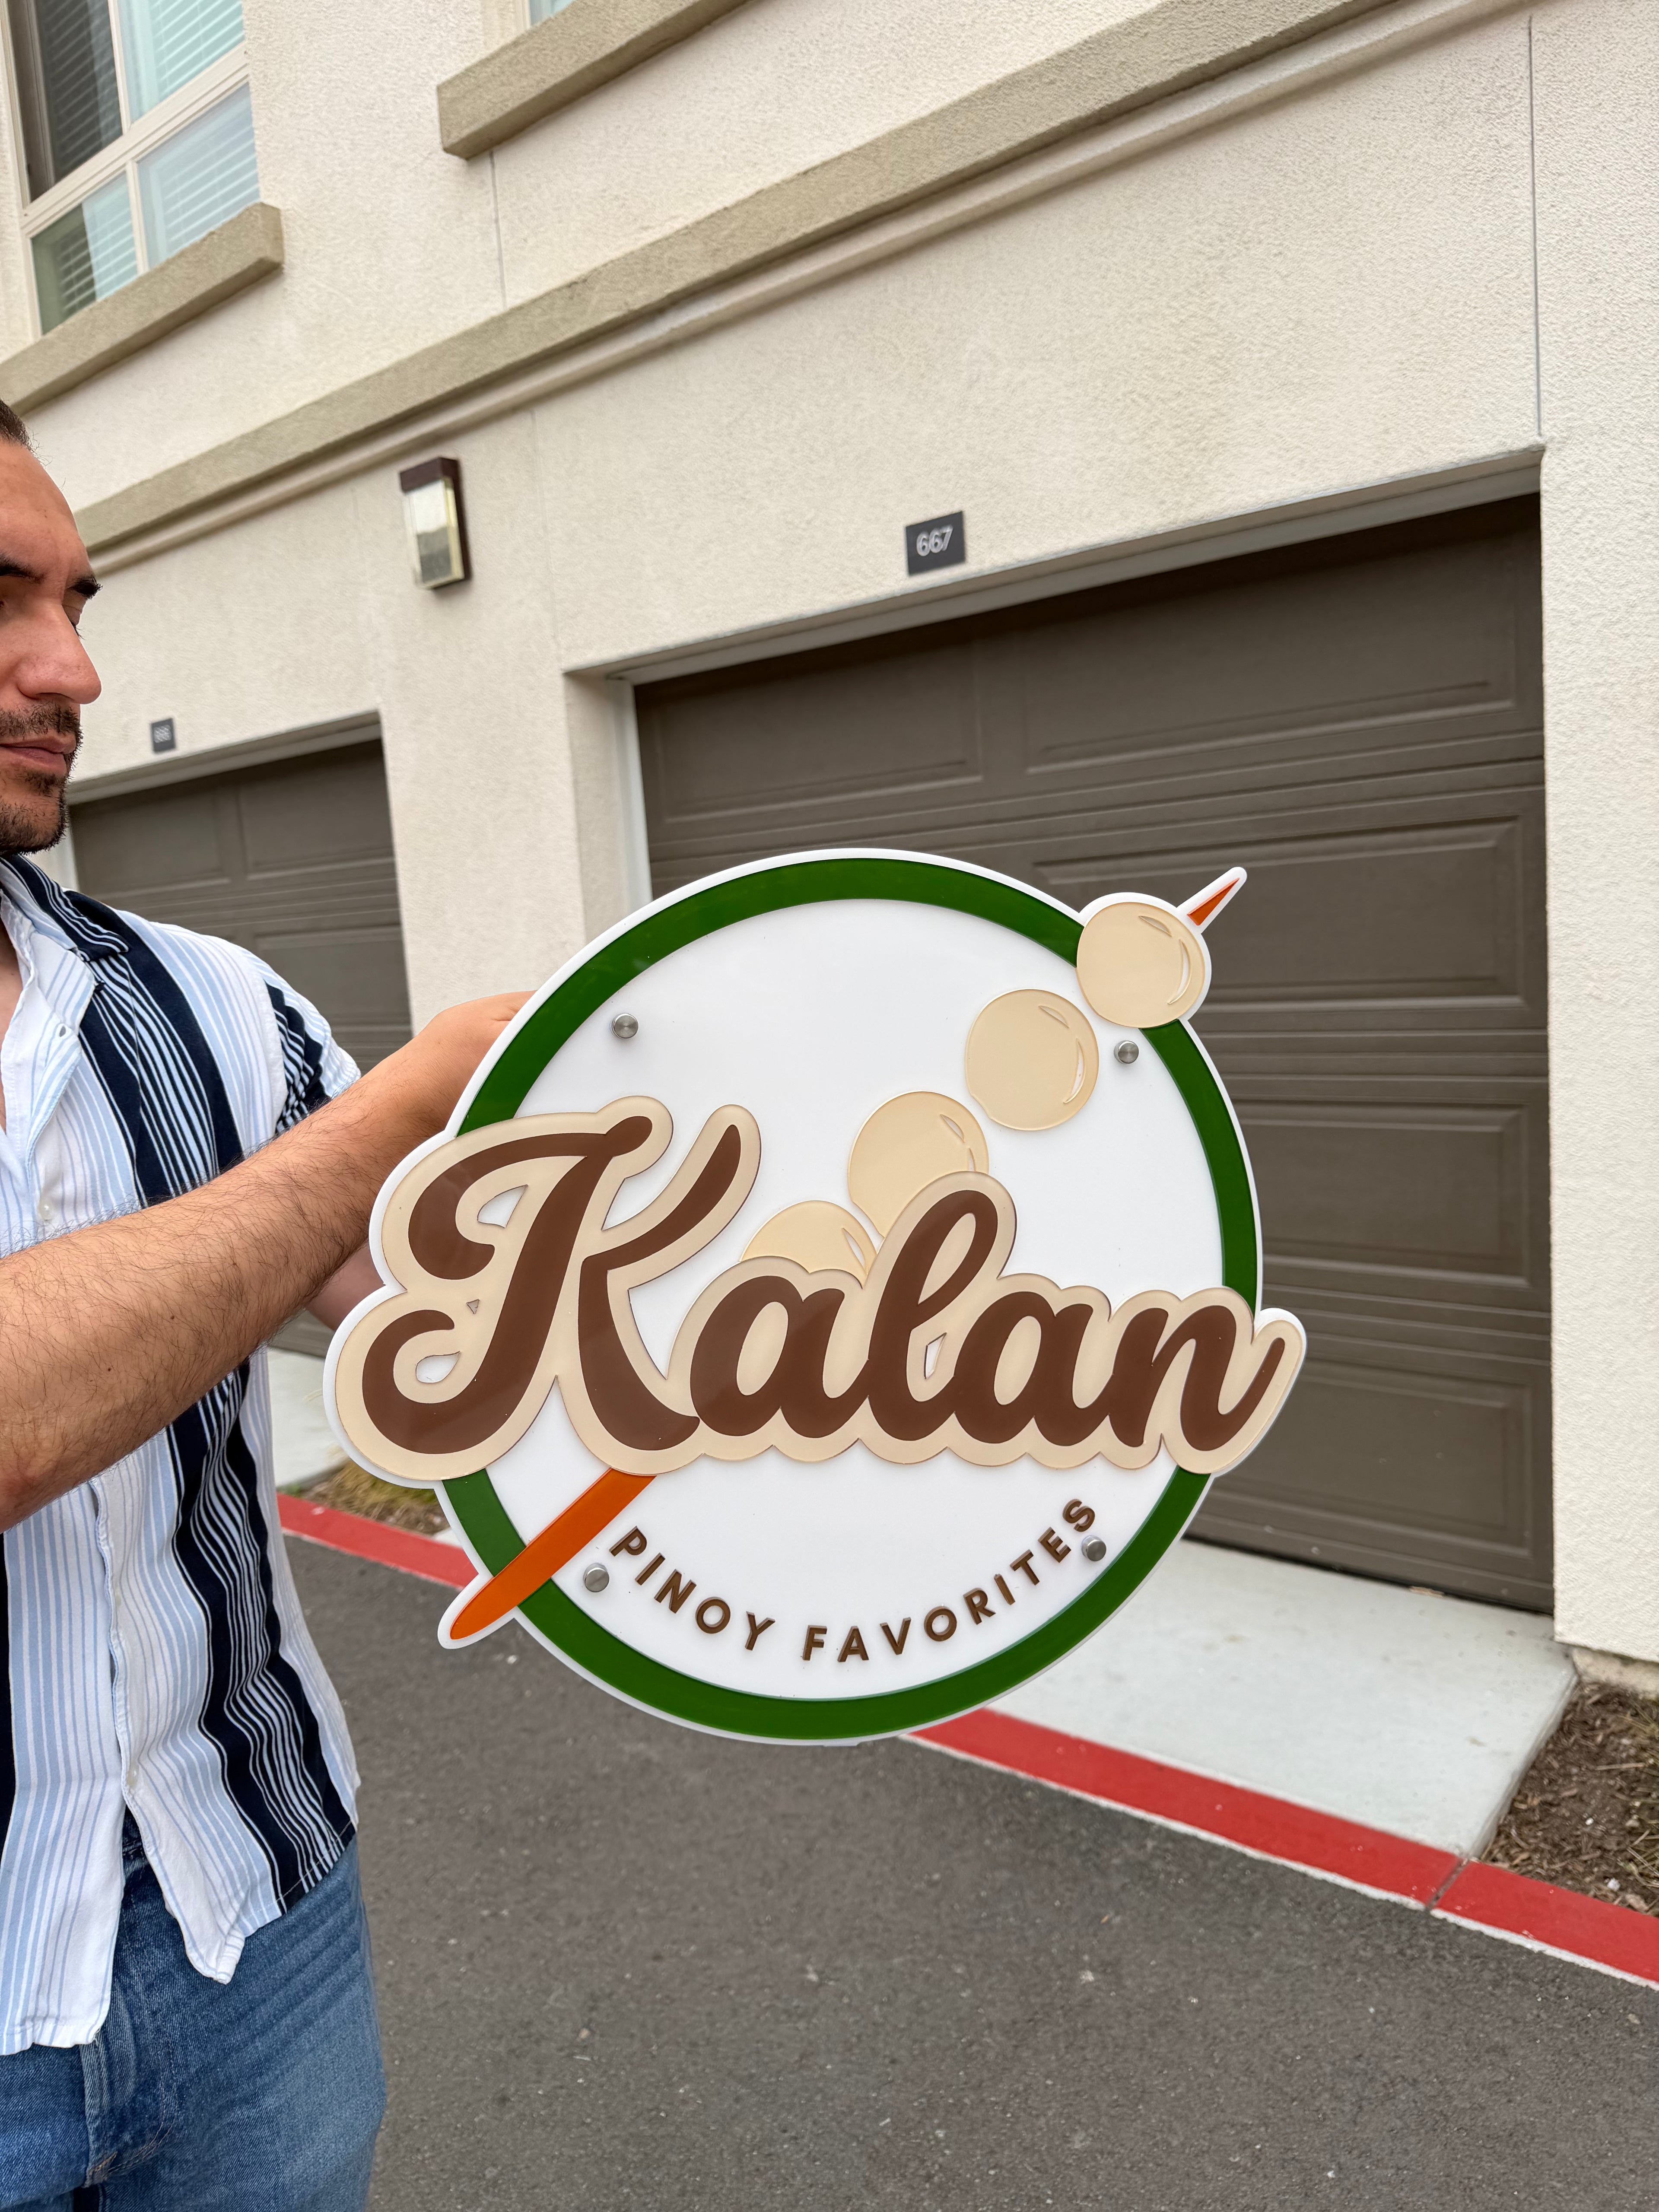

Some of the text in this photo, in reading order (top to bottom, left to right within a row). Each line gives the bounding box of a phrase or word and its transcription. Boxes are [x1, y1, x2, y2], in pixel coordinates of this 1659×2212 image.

[916, 524, 953, 557] 667
[362, 1116, 1285, 1454] Kalan
[608, 1498, 1096, 1663] PINOY FAVORITES
